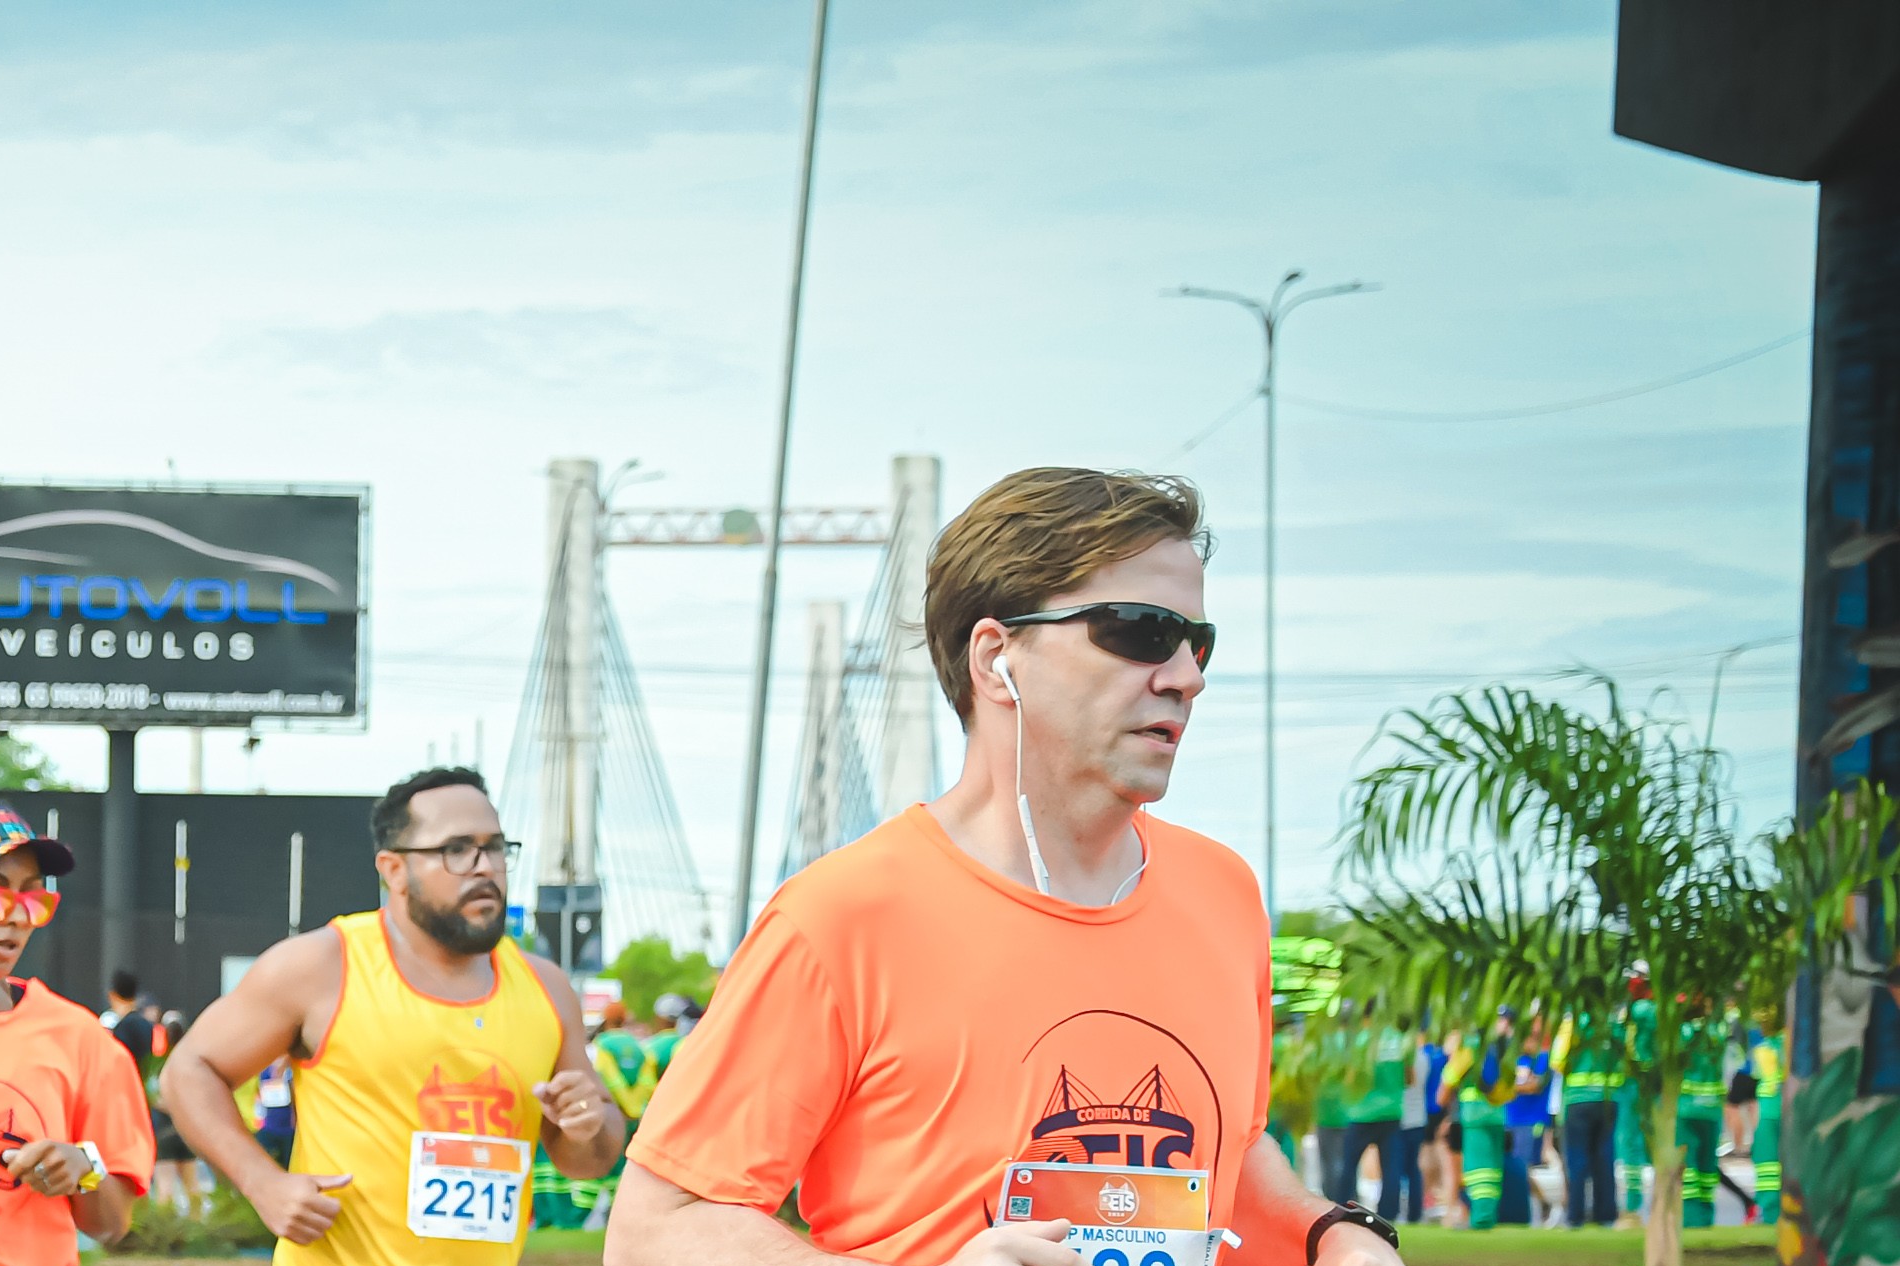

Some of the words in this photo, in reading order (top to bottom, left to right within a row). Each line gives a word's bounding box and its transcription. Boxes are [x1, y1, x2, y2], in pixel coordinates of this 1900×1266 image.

[0, 624, 255, 661] VEÍCULOS
[1076, 1107, 1131, 1123] CORRIDA
[1133, 1108, 1150, 1123] DE
[423, 1178, 517, 1223] 2215
[1082, 1228, 1166, 1245] MASCULINO
